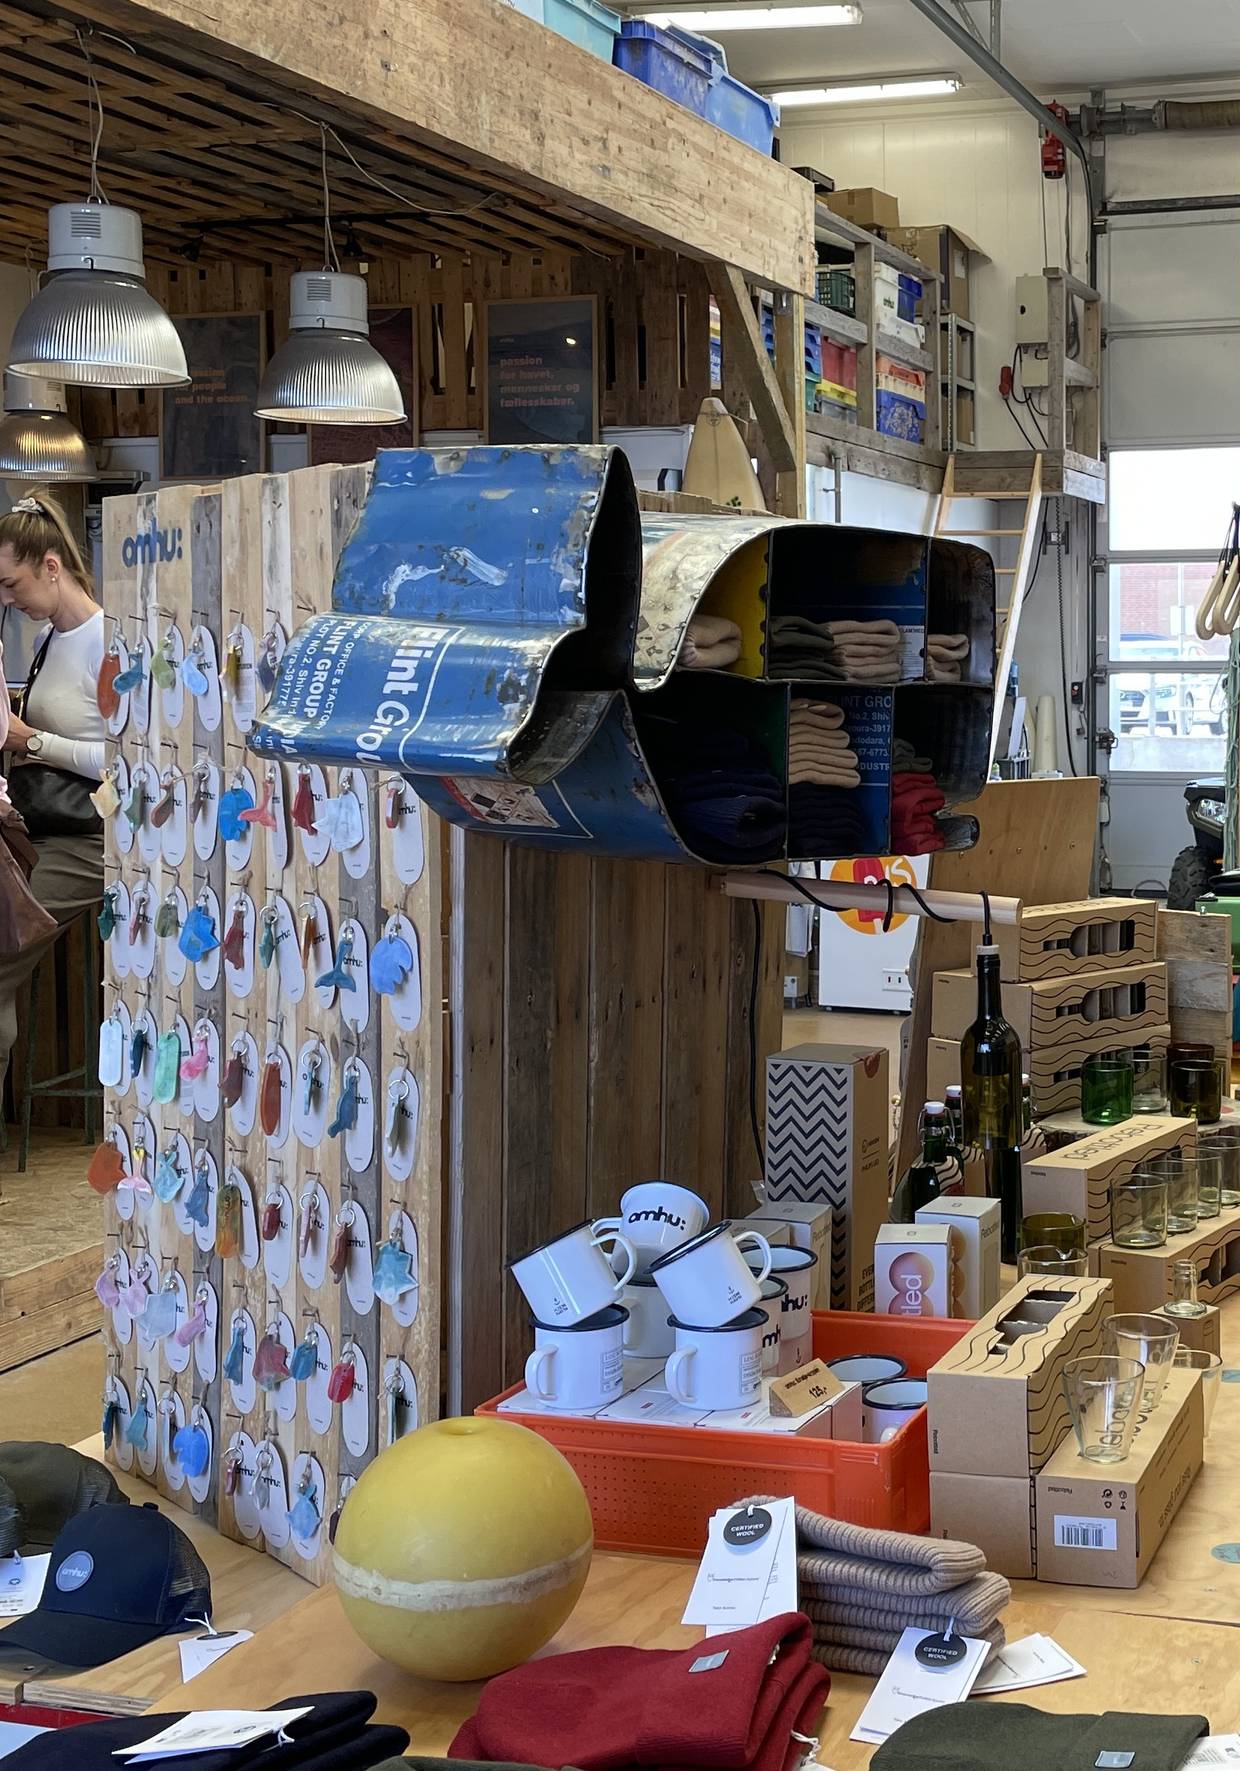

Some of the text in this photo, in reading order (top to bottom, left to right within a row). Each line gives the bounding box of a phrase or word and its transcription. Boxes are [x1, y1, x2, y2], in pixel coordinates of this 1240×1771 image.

[337, 641, 355, 675] OFFICE
[383, 626, 450, 695] Flint
[303, 619, 353, 719] FLINT GROUP
[628, 1206, 686, 1231] omhu:
[730, 1523, 765, 1533] CERTIFIED
[736, 1530, 756, 1538] WOOL
[923, 1646, 959, 1656] CERTIFIED
[928, 1652, 947, 1661] WOOL
